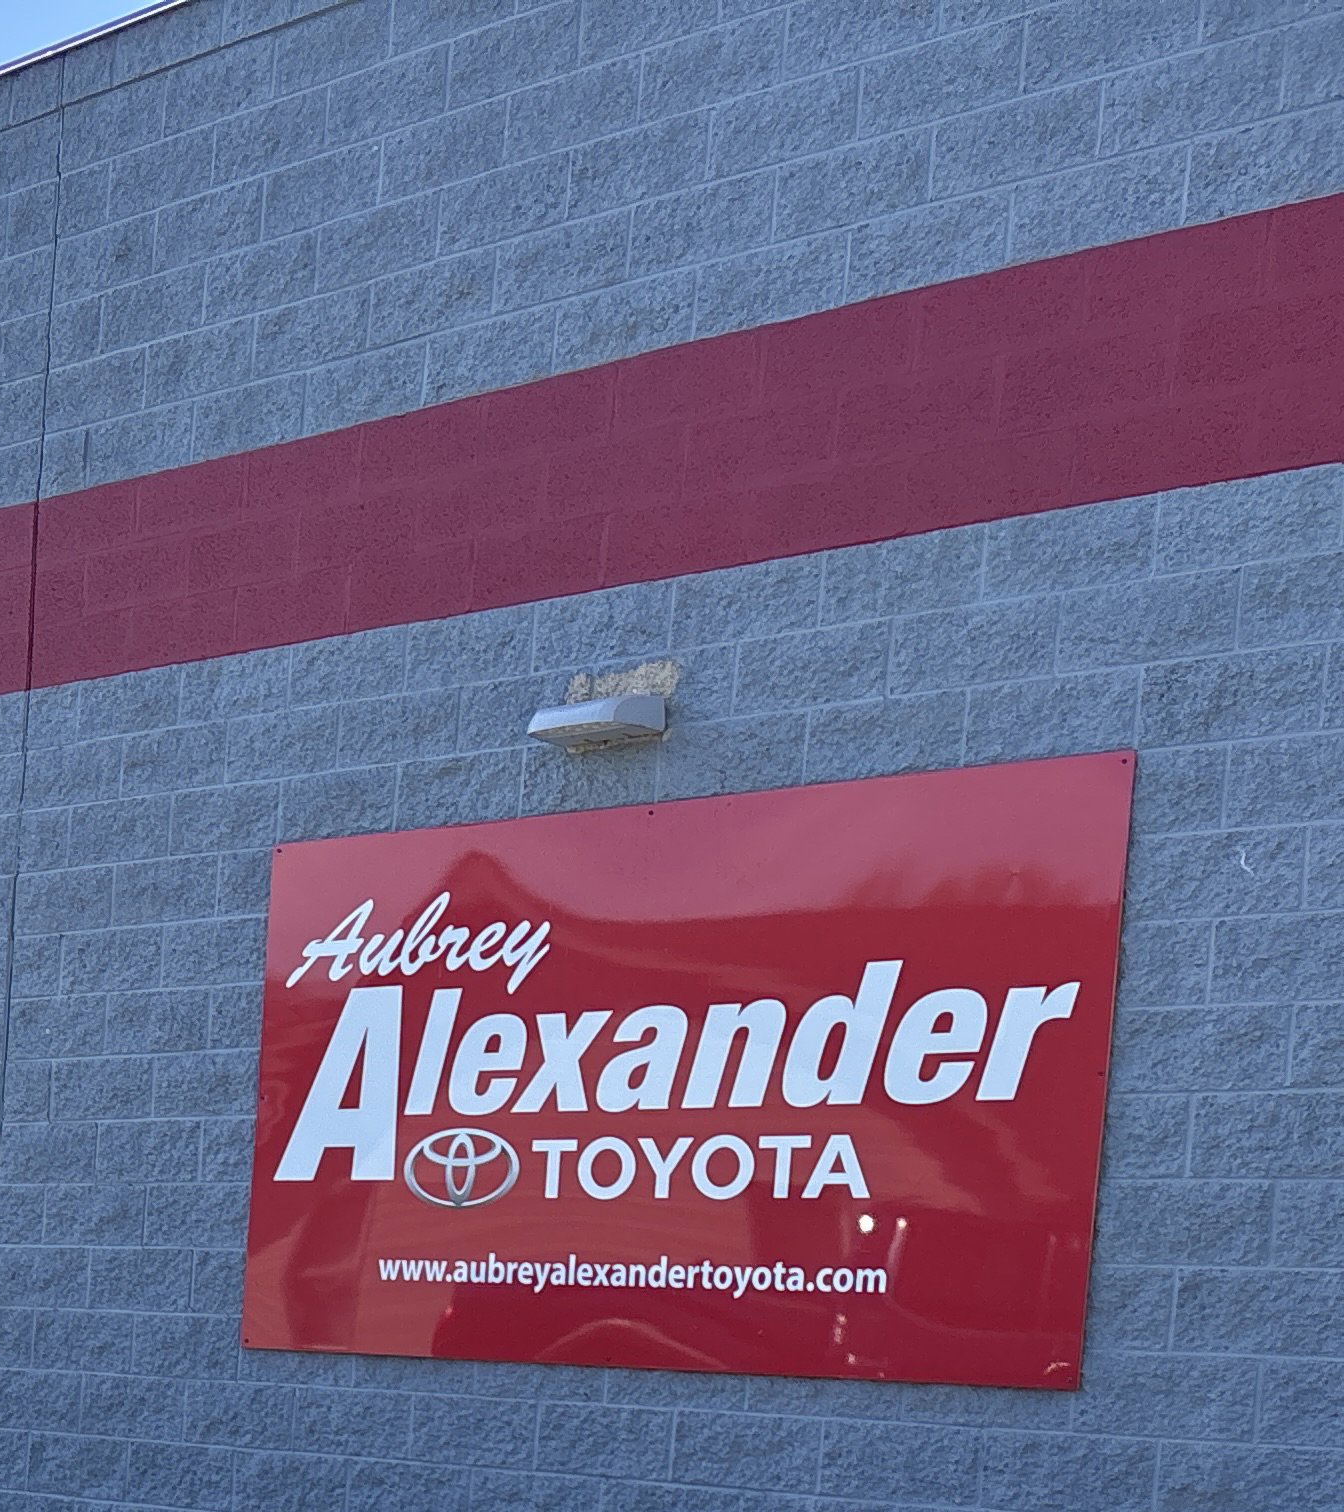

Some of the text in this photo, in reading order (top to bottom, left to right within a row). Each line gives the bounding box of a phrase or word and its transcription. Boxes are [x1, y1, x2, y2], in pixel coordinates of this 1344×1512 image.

[286, 891, 551, 994] Aubrey
[273, 959, 1081, 1182] Alexander
[531, 1134, 871, 1200] TOYOTA
[378, 1252, 887, 1299] www.aubreyalexandertoyota.com
